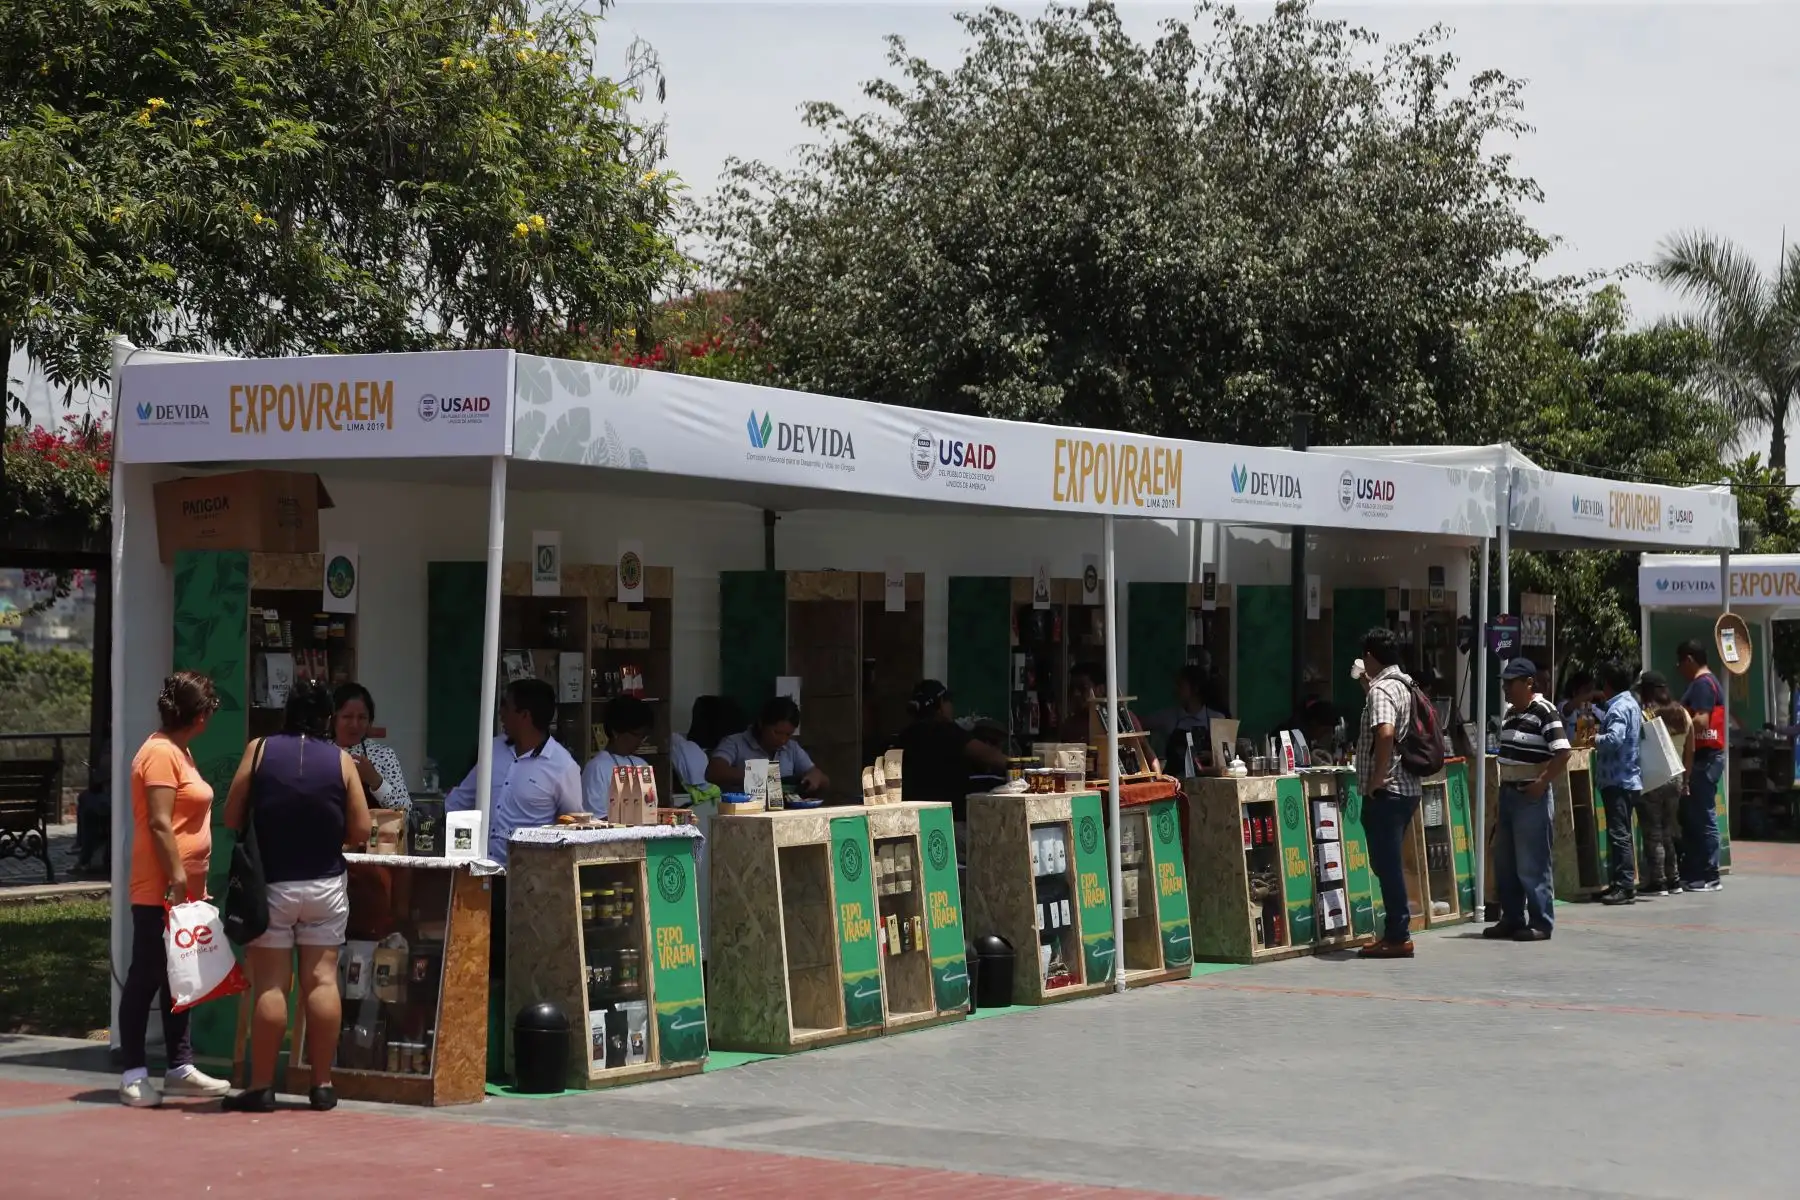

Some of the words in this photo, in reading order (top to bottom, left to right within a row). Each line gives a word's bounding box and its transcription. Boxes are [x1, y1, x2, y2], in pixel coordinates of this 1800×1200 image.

[156, 404, 209, 420] DEVIDA
[230, 379, 393, 434] EXPOVRAEM
[441, 397, 491, 413] USAID
[347, 423, 365, 431] LIMA
[367, 422, 385, 431] 2019
[777, 422, 855, 460] DEVIDA
[939, 439, 997, 470] USAID
[1053, 438, 1183, 508] EXPOVRAEM
[1251, 472, 1302, 499] DEVIDA
[1357, 478, 1395, 501] USAID
[1146, 499, 1161, 508] LIMA
[1161, 499, 1175, 509] 2019
[1580, 499, 1604, 517] DEVIDA
[1609, 490, 1661, 531] EXPOVRAEM
[1675, 509, 1693, 524] USAID
[1672, 580, 1716, 591] DEVIDA
[929, 890, 949, 909] EXPO
[841, 902, 862, 921] EXPO
[174, 924, 213, 949] oe
[657, 926, 683, 948] EXPO
[658, 943, 697, 970] VRAEM
